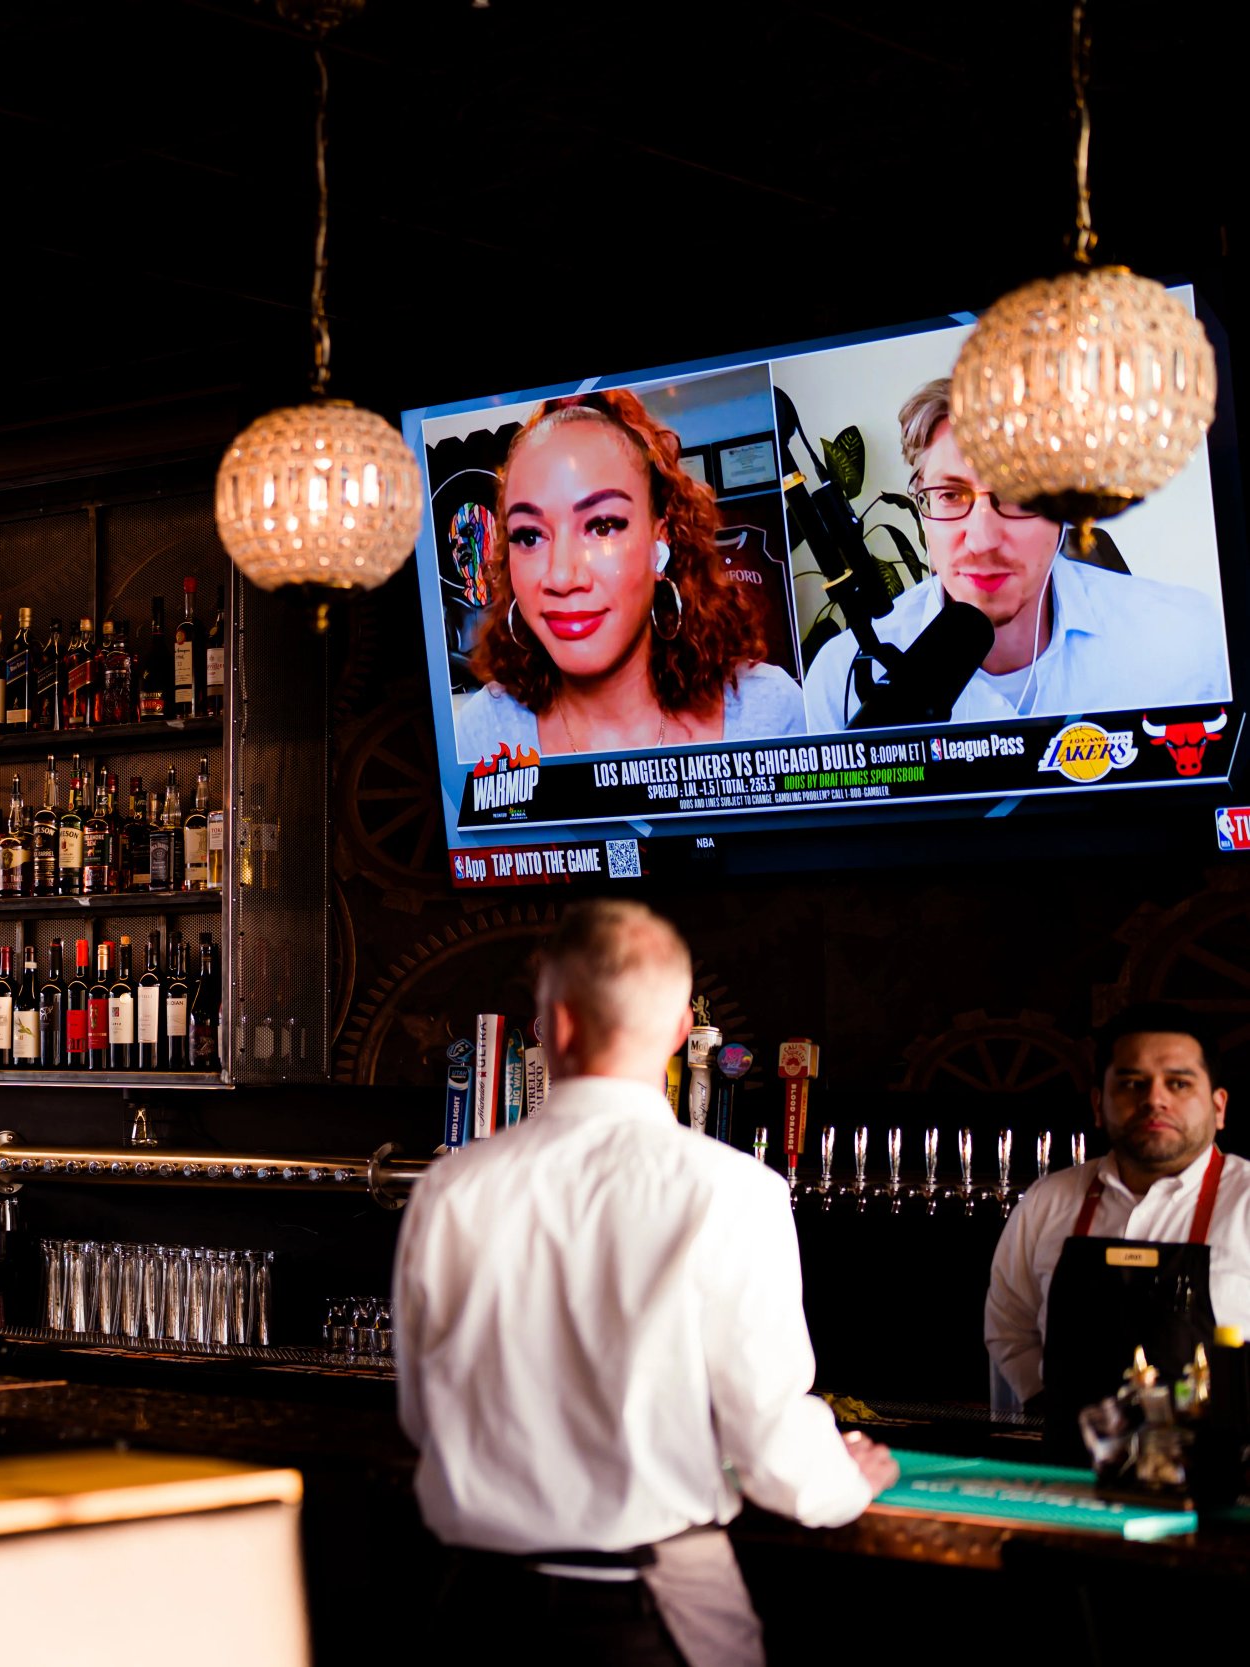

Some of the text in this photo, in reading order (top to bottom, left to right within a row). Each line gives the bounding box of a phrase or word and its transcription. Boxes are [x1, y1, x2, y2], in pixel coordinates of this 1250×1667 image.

[498, 757, 508, 772] THE
[594, 734, 1025, 787] LOS ANGELES LAKERS VS CHICAGO BULLS 8:00PM ET League Pass
[1047, 740, 1129, 768] LAKERS
[473, 766, 539, 812] WARMUP
[648, 767, 925, 800] SPREAD LAL -1.5 TOTAL: 235.5 ODDS BY DRAFTKINGS SPORTSBOOK
[830, 788, 845, 800] CALL
[696, 837, 715, 848] NBA
[465, 848, 602, 882] App TAP INTO THE GAME
[479, 1021, 487, 1067] ULTRA
[513, 1062, 522, 1106] BIG WAVE
[452, 1096, 460, 1122] LIGHT
[788, 1115, 796, 1151] ORANGE
